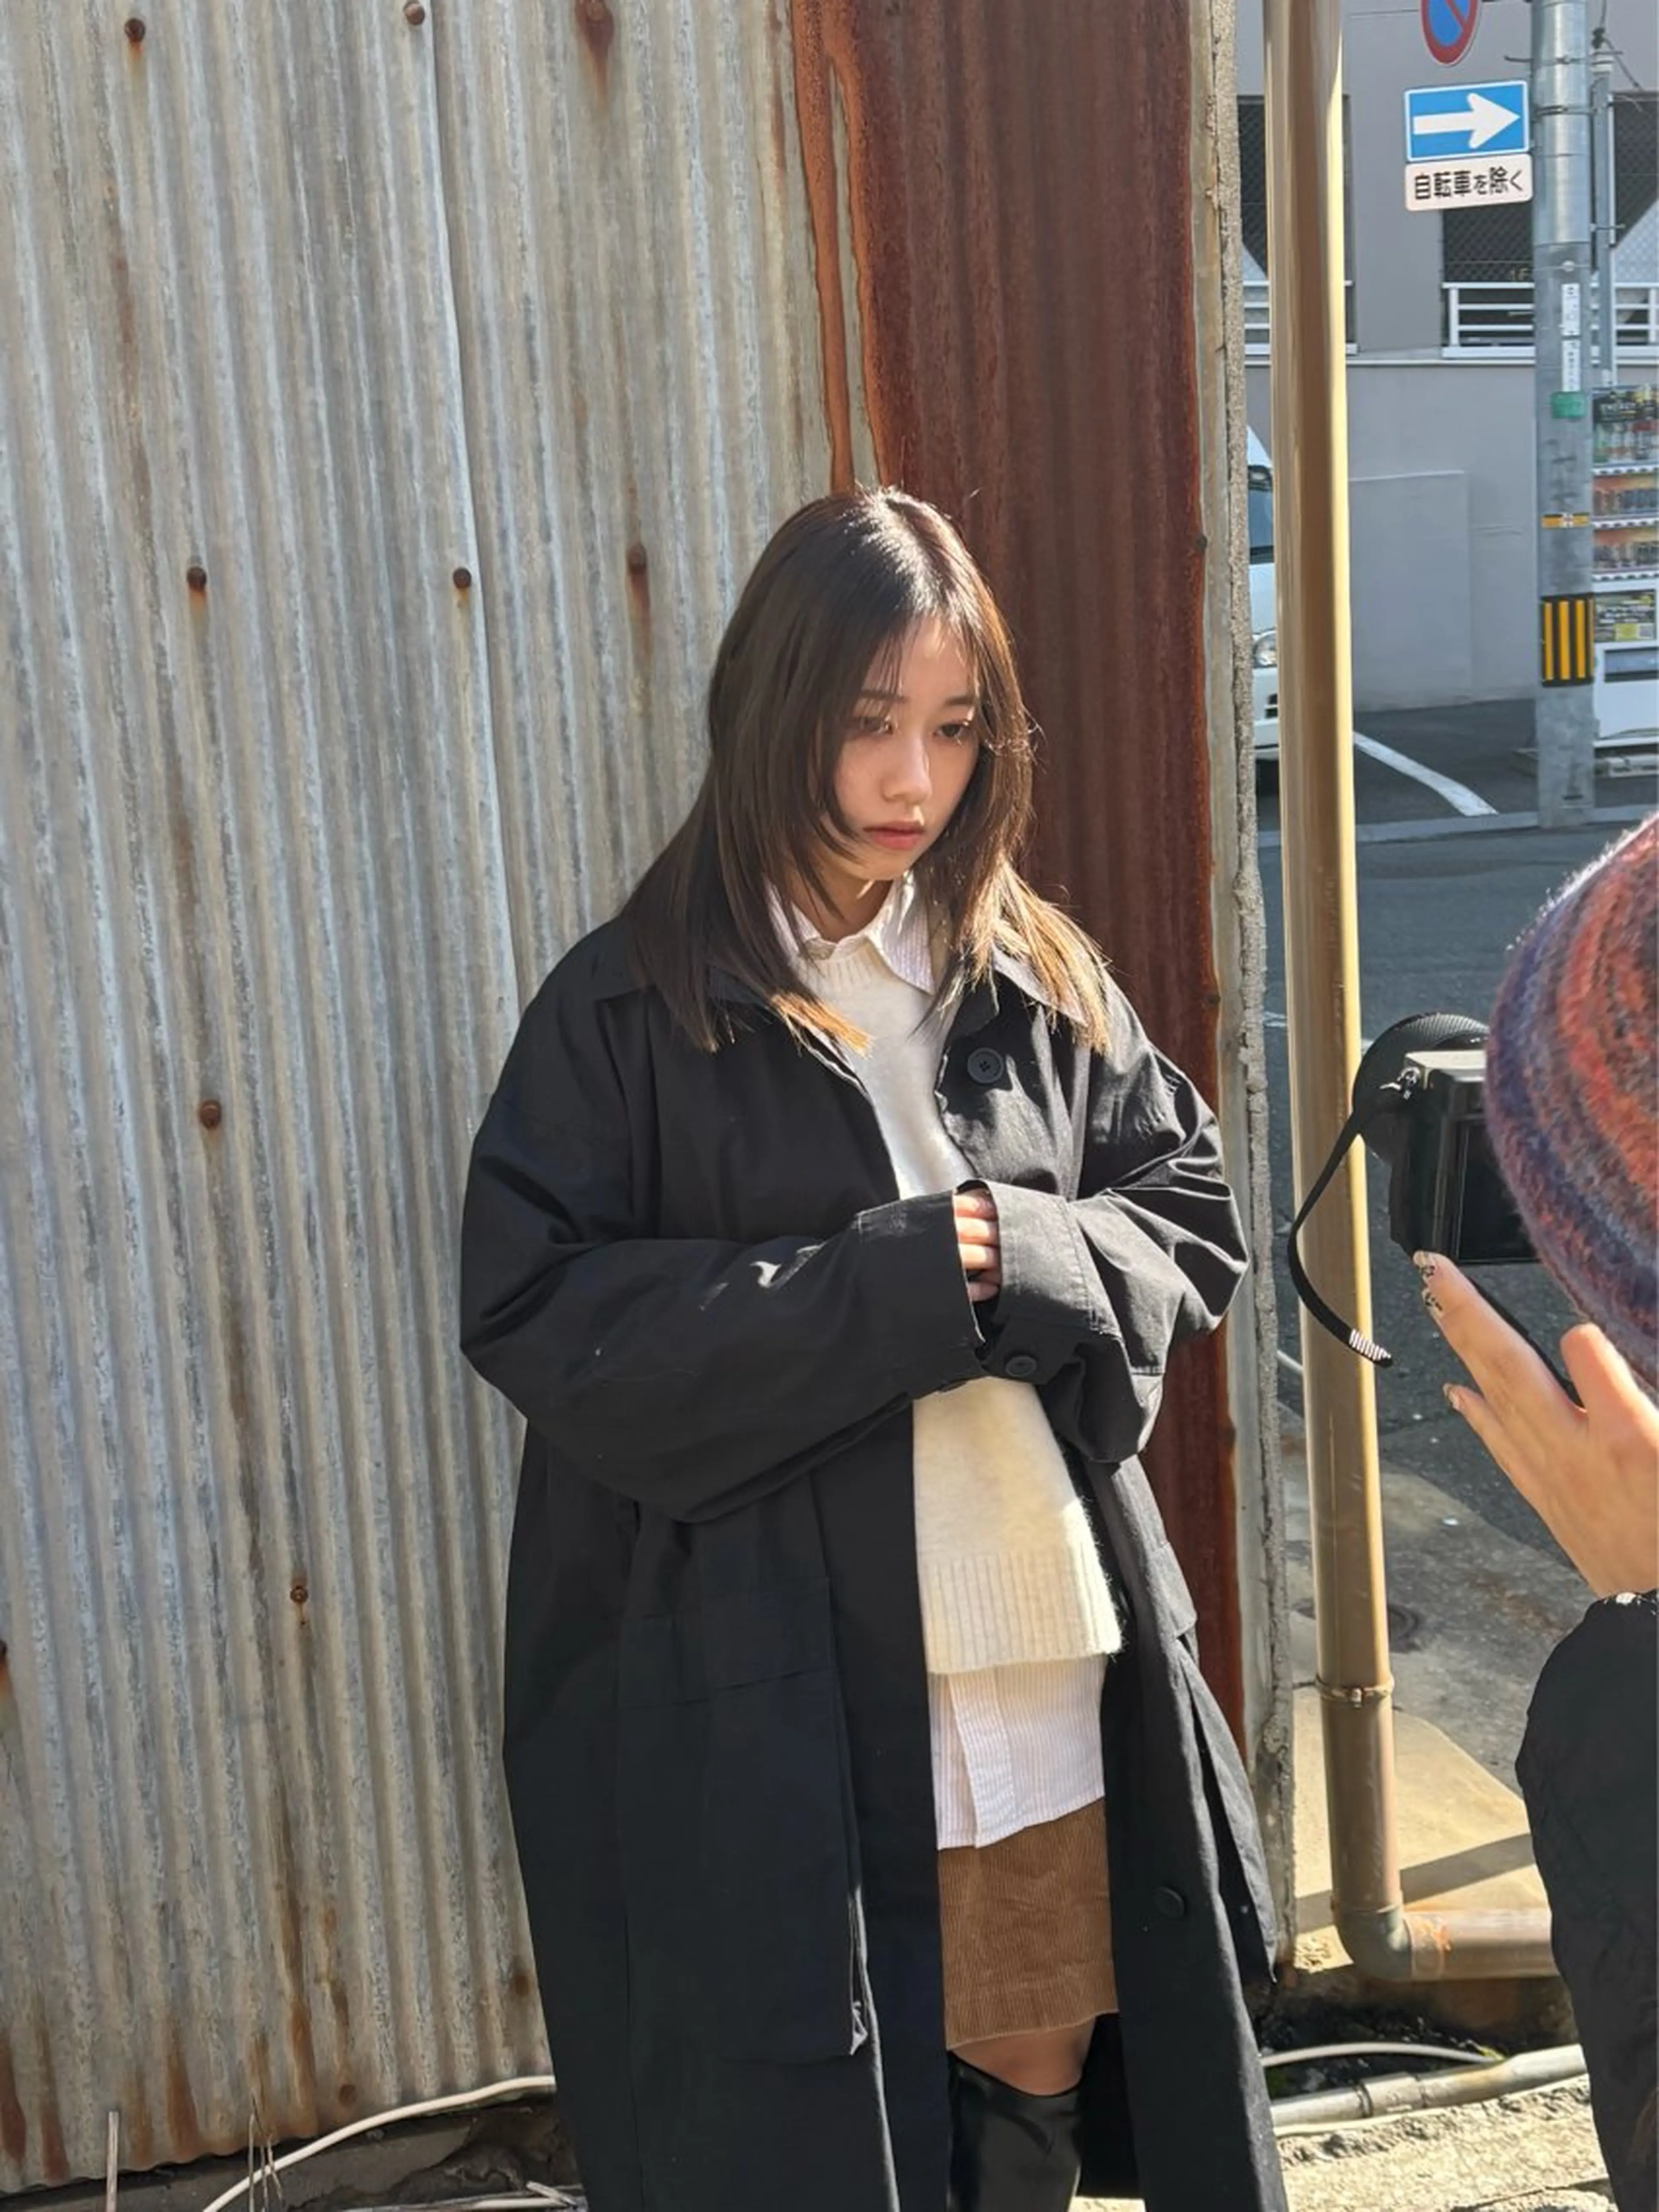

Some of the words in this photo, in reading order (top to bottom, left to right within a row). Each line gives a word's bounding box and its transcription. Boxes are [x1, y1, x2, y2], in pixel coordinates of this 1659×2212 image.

[1414, 165, 1523, 200] 自転車を除く
